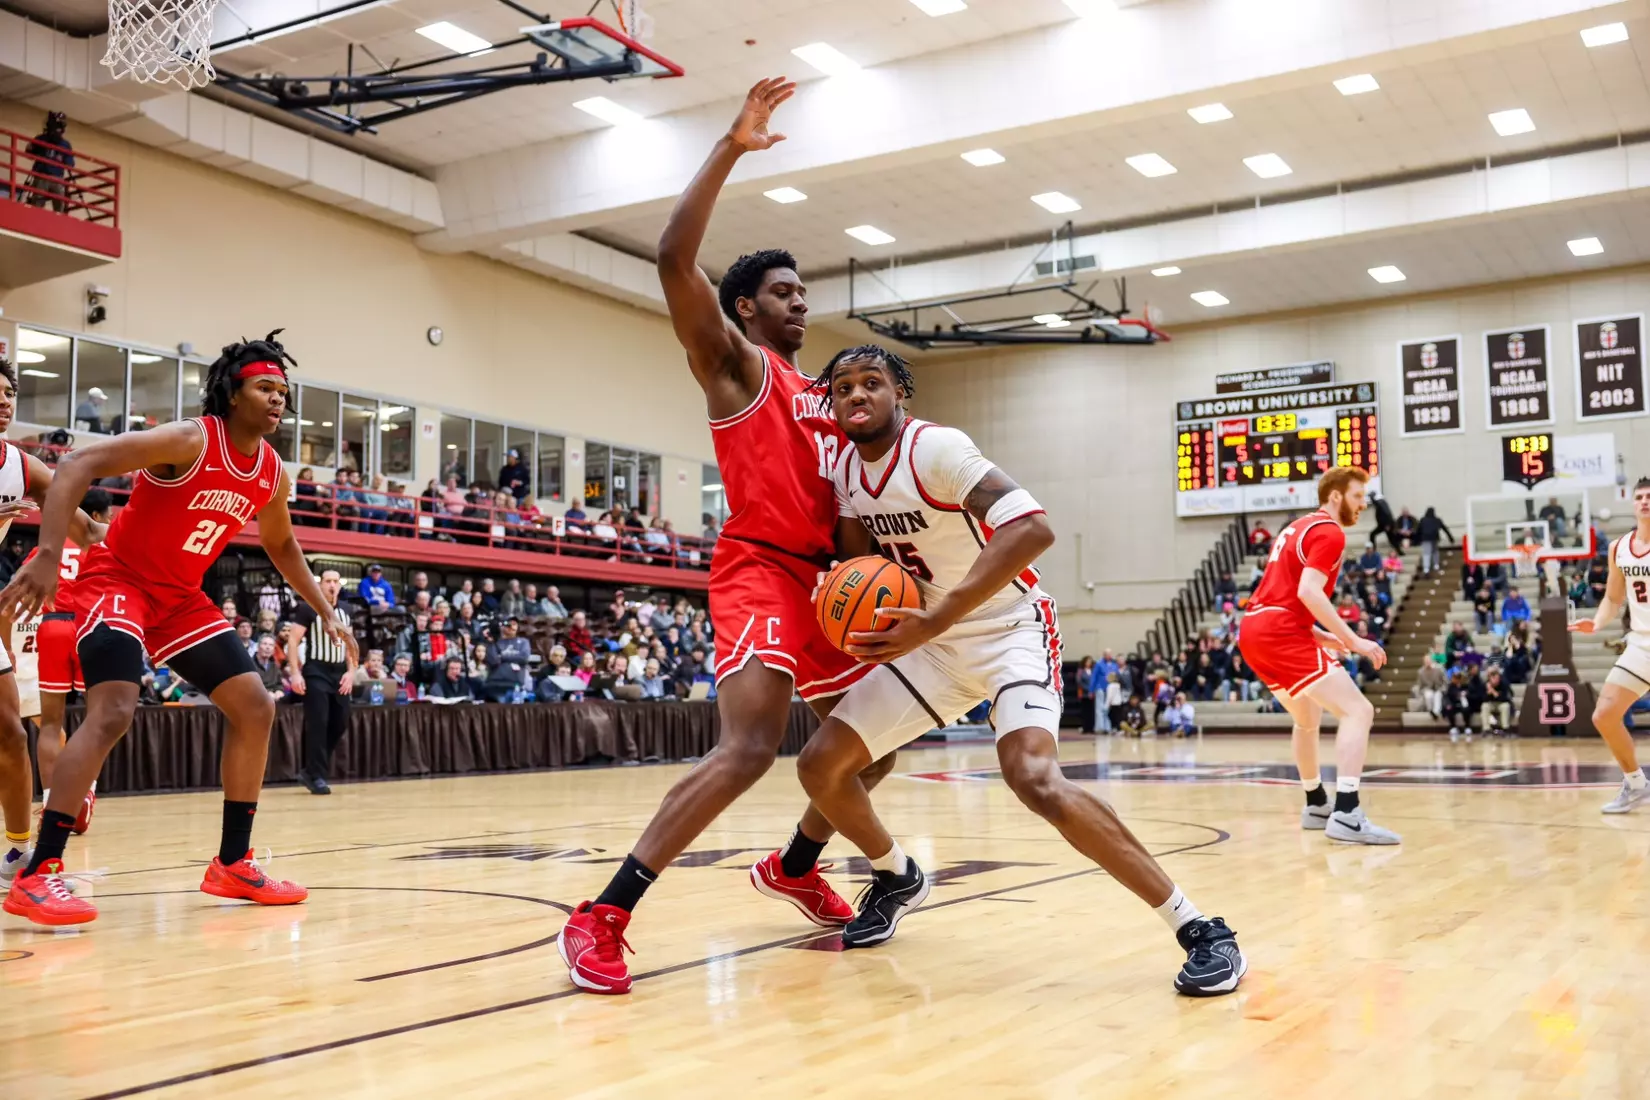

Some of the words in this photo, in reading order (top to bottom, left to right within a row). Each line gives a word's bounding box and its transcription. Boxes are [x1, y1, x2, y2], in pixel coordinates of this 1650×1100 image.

[1500, 369, 1537, 385] NCAA
[1596, 363, 1624, 382] NIT
[1413, 378, 1448, 394] NCAA
[1195, 398, 1253, 417] BROWN
[1258, 387, 1353, 411] UNIVERSITY
[1589, 387, 1635, 409] 2003
[814, 431, 838, 481] 12
[1236, 445, 1248, 462] 5
[1315, 437, 1328, 455] 6
[1522, 451, 1544, 476] 15
[182, 519, 228, 555] 21
[60, 548, 81, 580] 5
[830, 568, 866, 622] ELITE
[1633, 581, 1648, 603] 2
[113, 594, 126, 614] C
[767, 617, 780, 645] C
[22, 636, 38, 654] 2
[1538, 683, 1574, 724] B
